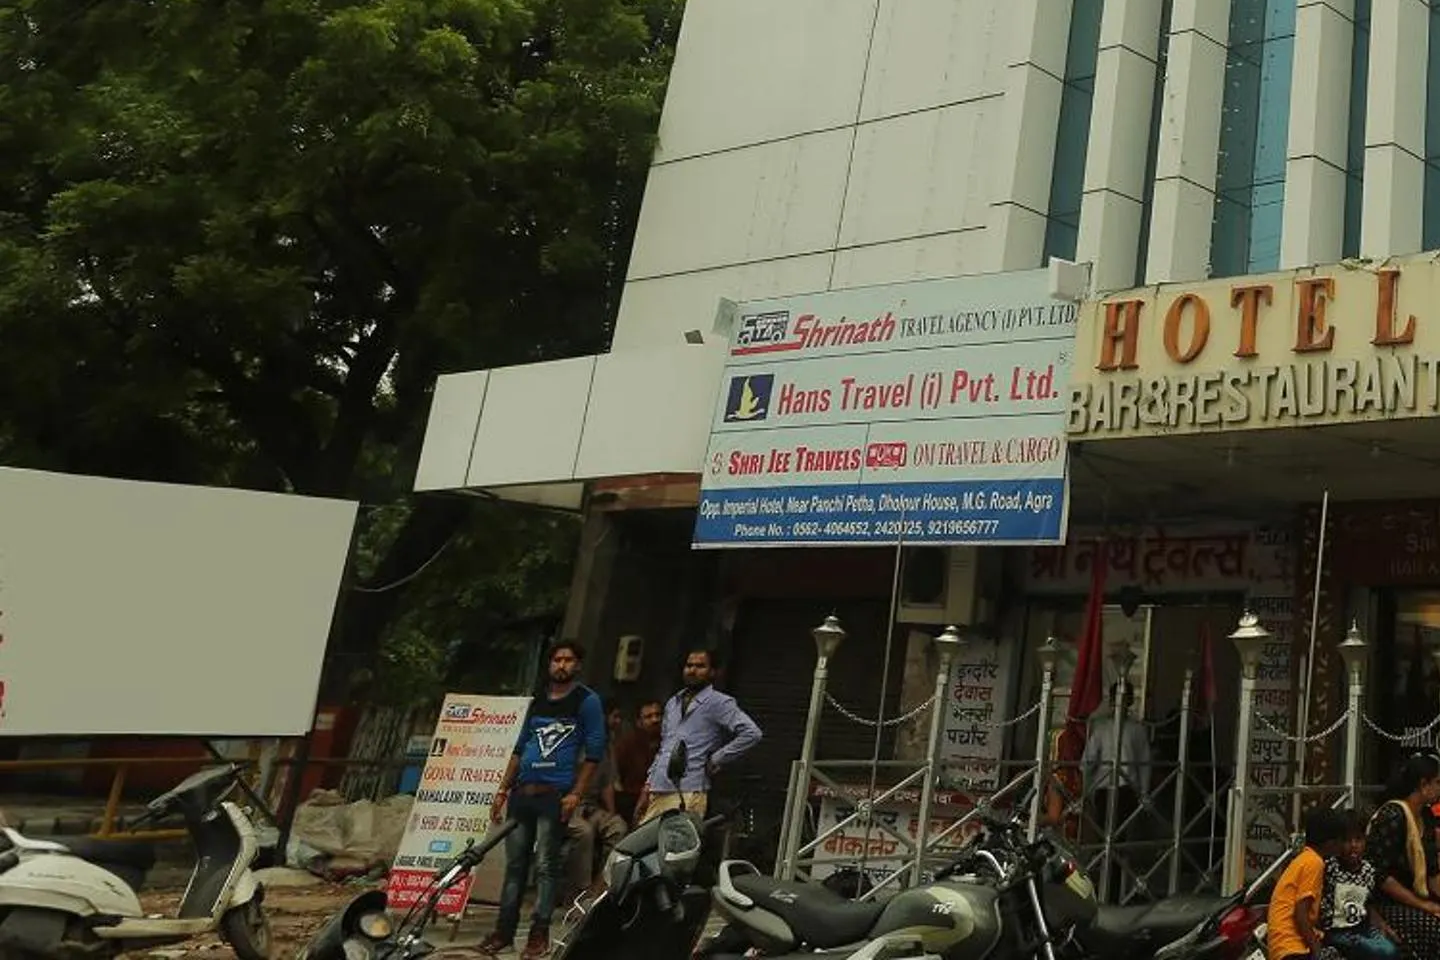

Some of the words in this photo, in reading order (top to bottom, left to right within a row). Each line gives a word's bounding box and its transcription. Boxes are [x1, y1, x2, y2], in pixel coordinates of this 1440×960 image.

[793, 311, 896, 349] Shrinath
[900, 313, 945, 338] TRAVEL
[948, 310, 1000, 334] AGENCY
[1095, 269, 1416, 372] HOTEL
[777, 383, 831, 415] Hans
[840, 373, 914, 410] Travel
[920, 371, 942, 409] (i)
[950, 369, 999, 403] Pvt.
[1010, 364, 1059, 400] Ltd.
[728, 450, 764, 475] SHRI
[767, 448, 791, 473] JEE
[796, 445, 861, 473] TRAVELS
[913, 443, 935, 467] OM
[938, 440, 986, 466] TRAVEL
[992, 440, 1003, 464] &
[1006, 436, 1060, 464] CARGO
[810, 494, 845, 513] Panchi
[922, 492, 959, 513] House,
[989, 491, 1022, 511] Road,
[1024, 490, 1053, 513] Agra
[734, 523, 765, 537] Phone
[460, 767, 504, 782] TRAVELS
[464, 791, 493, 805] TRAVEL
